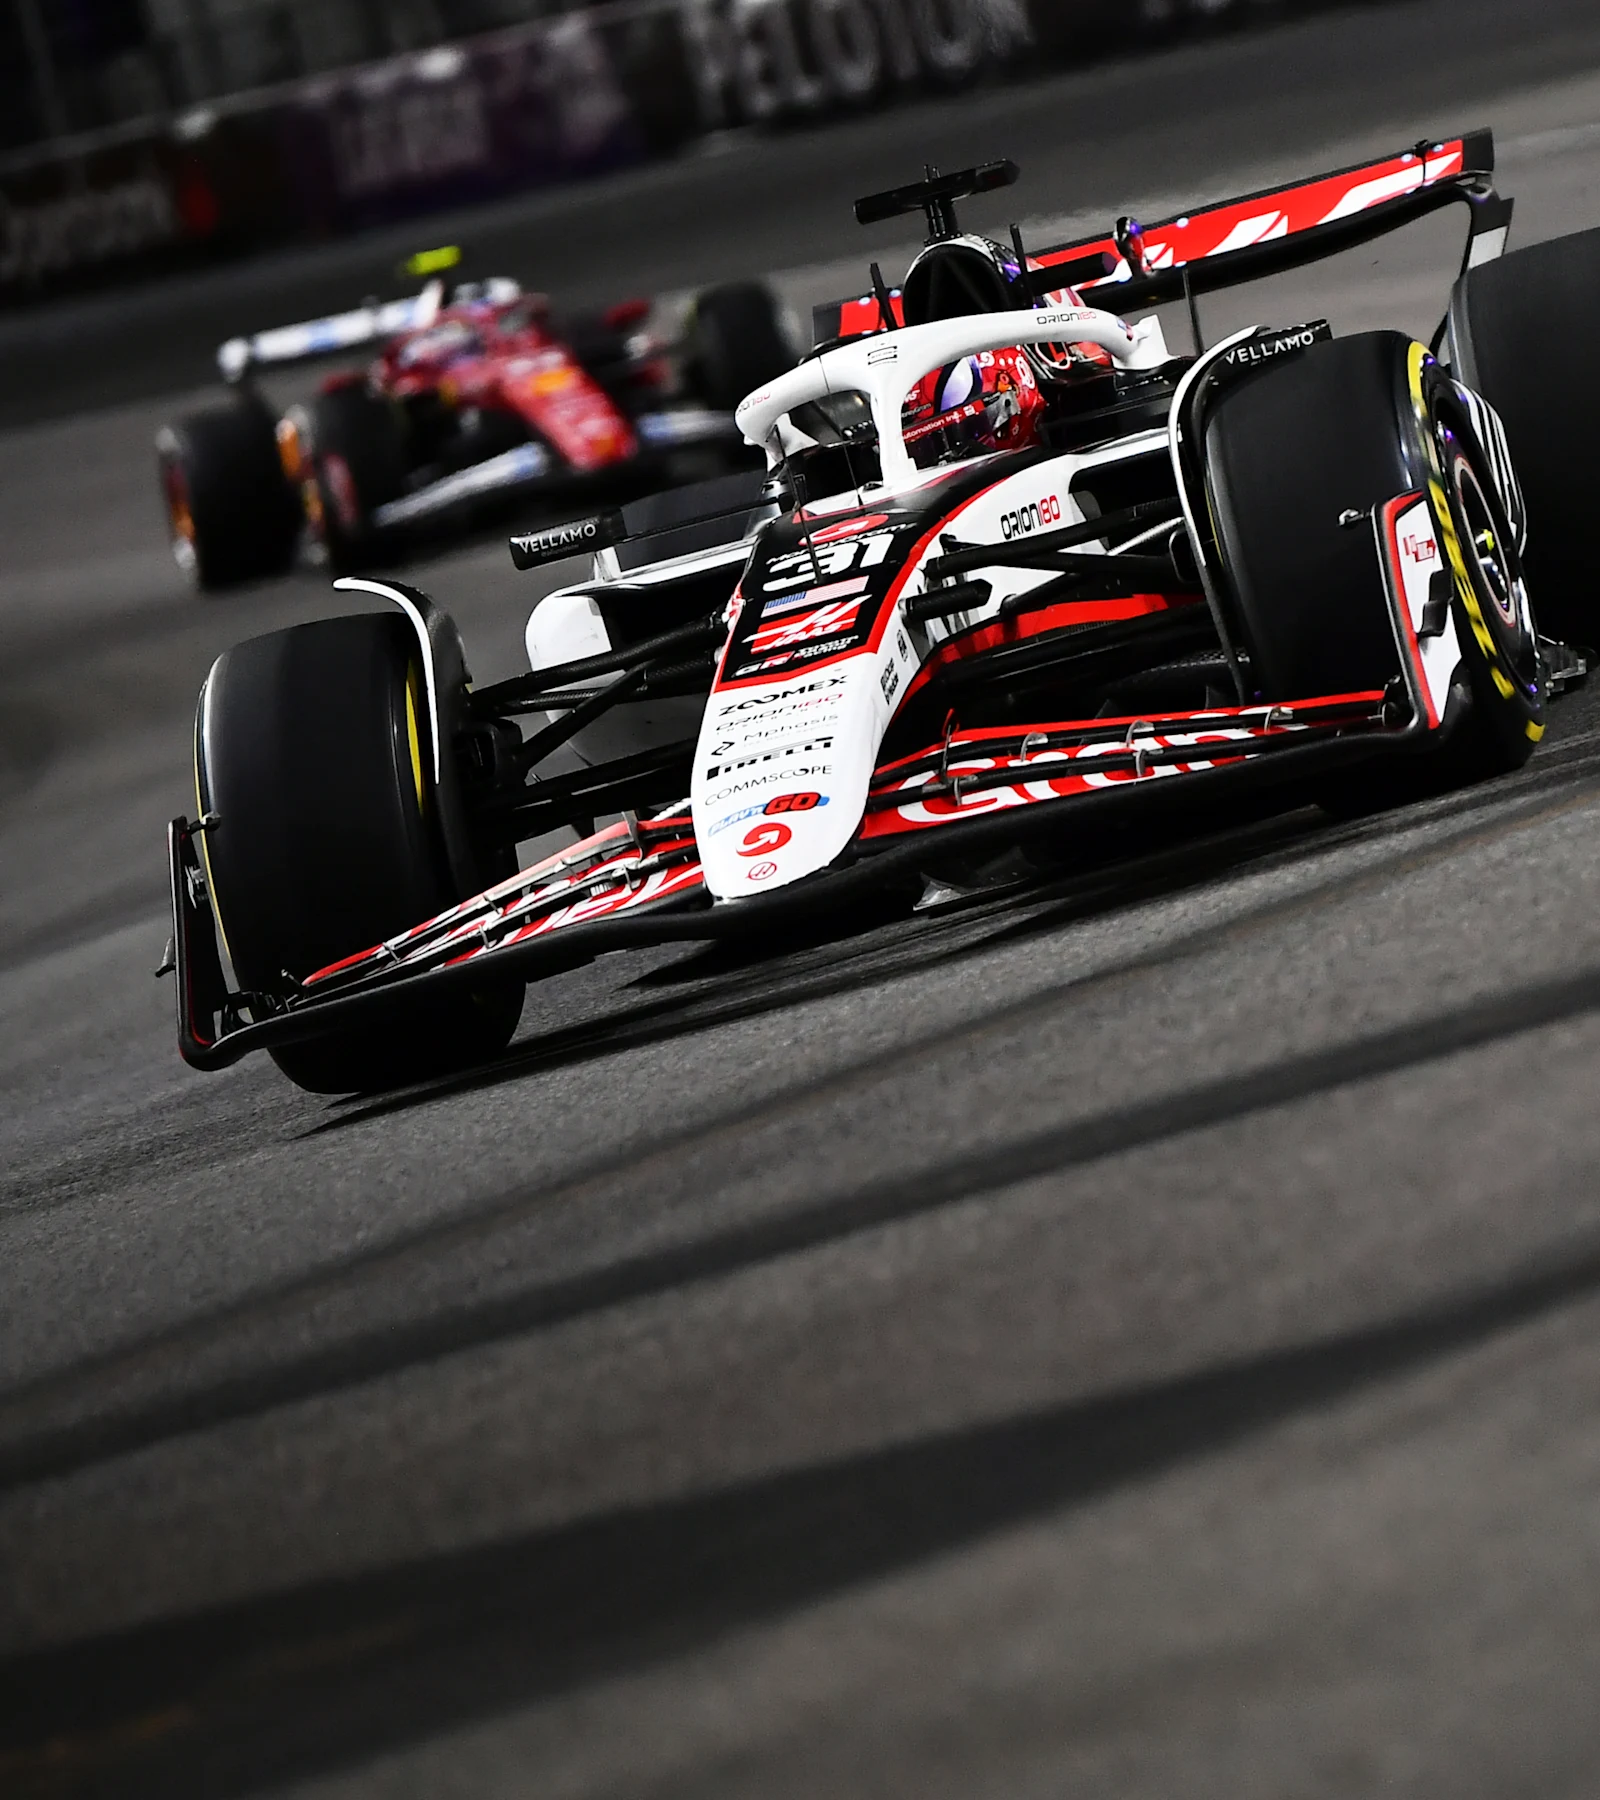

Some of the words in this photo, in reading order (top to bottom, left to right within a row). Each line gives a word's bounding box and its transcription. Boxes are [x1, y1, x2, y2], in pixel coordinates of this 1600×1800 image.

[1037, 312, 1097, 325] ORION180
[1226, 331, 1314, 365] VELLAMO
[901, 403, 931, 418] oneyGram
[903, 419, 945, 440] utomation
[1000, 494, 1061, 541] ORION180
[520, 524, 596, 554] VELLAMO
[763, 534, 894, 592] 31
[716, 693, 843, 731] ORION180
[718, 675, 847, 717] ZOOMEX
[744, 715, 838, 741] Mphasis
[706, 736, 834, 781] PIRELLI
[705, 765, 832, 806] COMMSCOPE
[763, 791, 821, 815] GO
